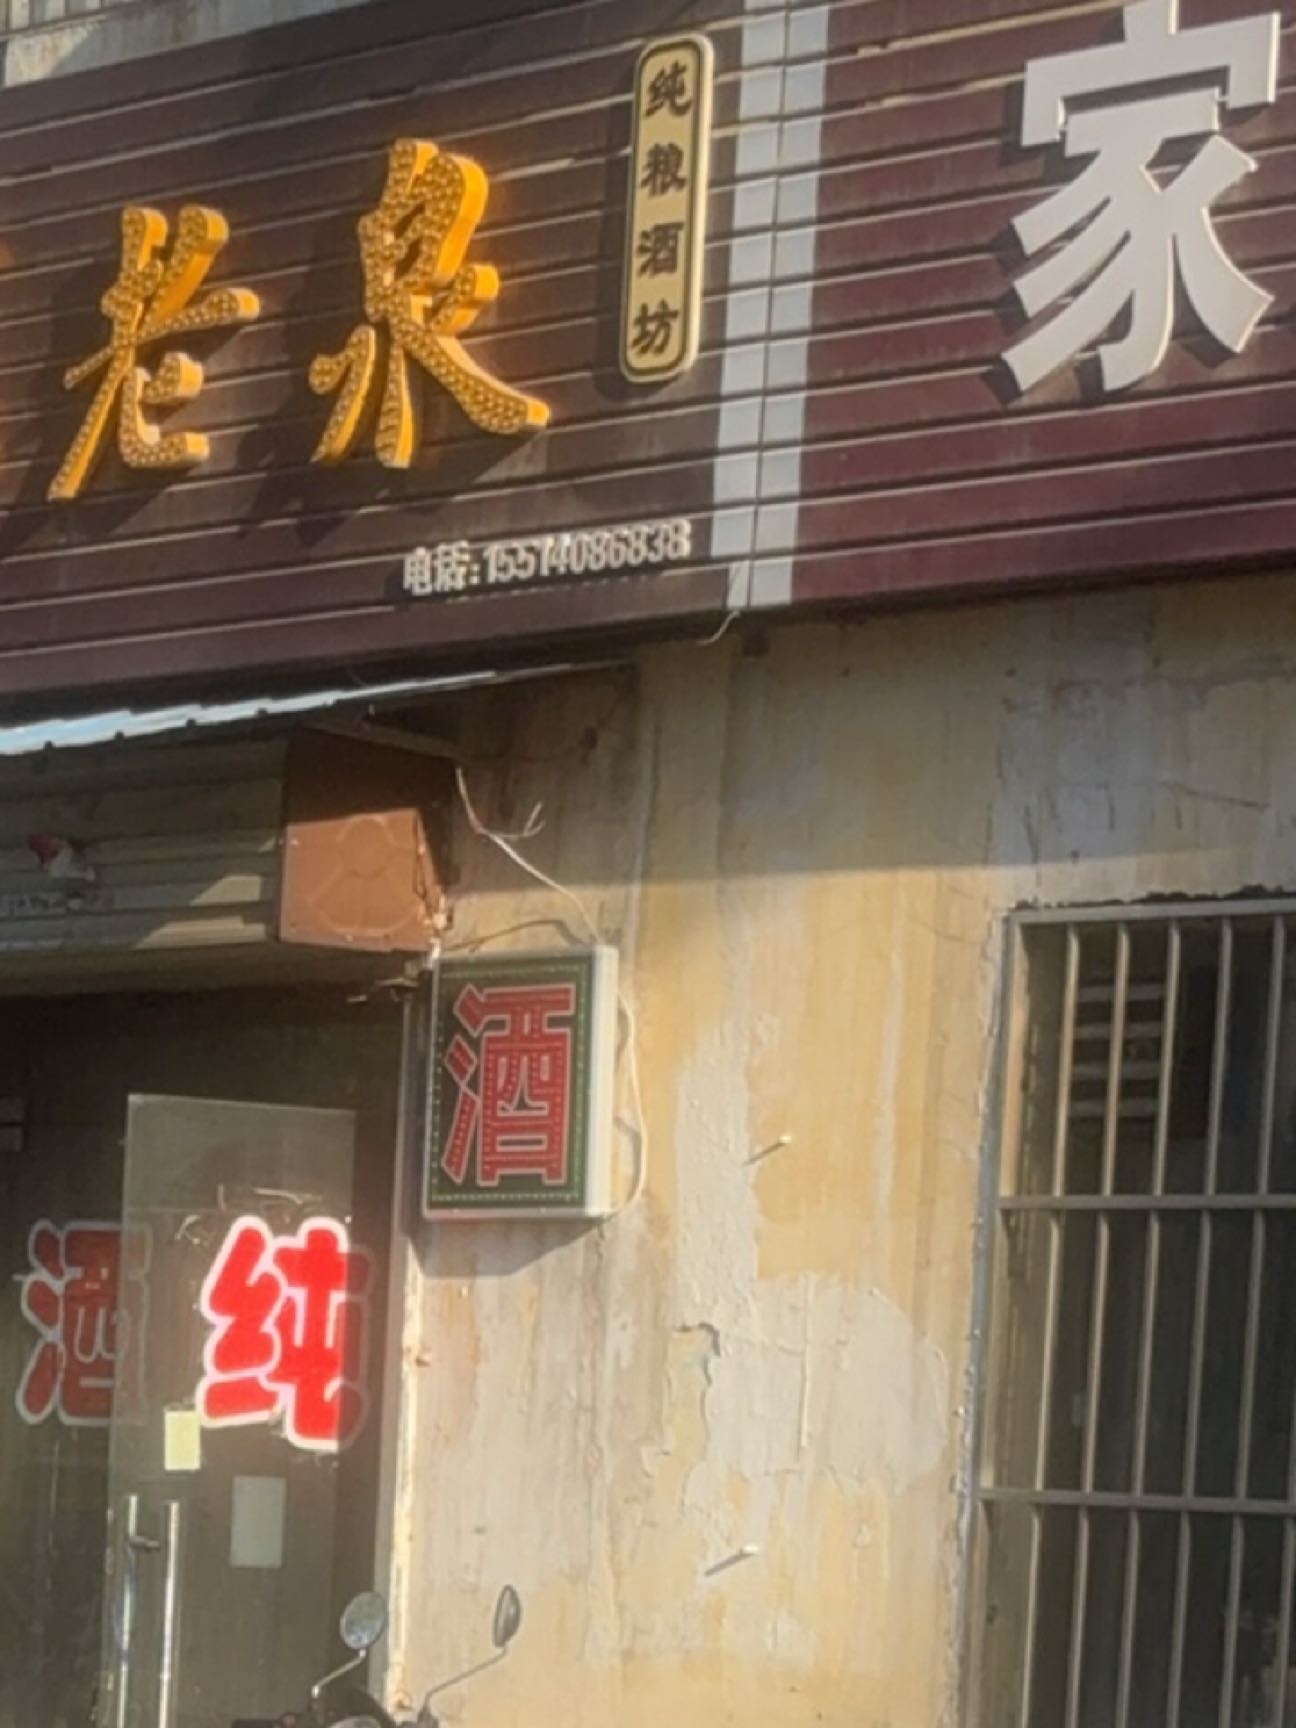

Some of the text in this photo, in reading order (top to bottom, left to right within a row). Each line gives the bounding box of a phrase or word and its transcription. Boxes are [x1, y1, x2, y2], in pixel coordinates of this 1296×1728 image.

[632, 60, 694, 357] 纯粮酒坊
[1002, 0, 1281, 391] 家
[441, 982, 576, 1187] 酒
